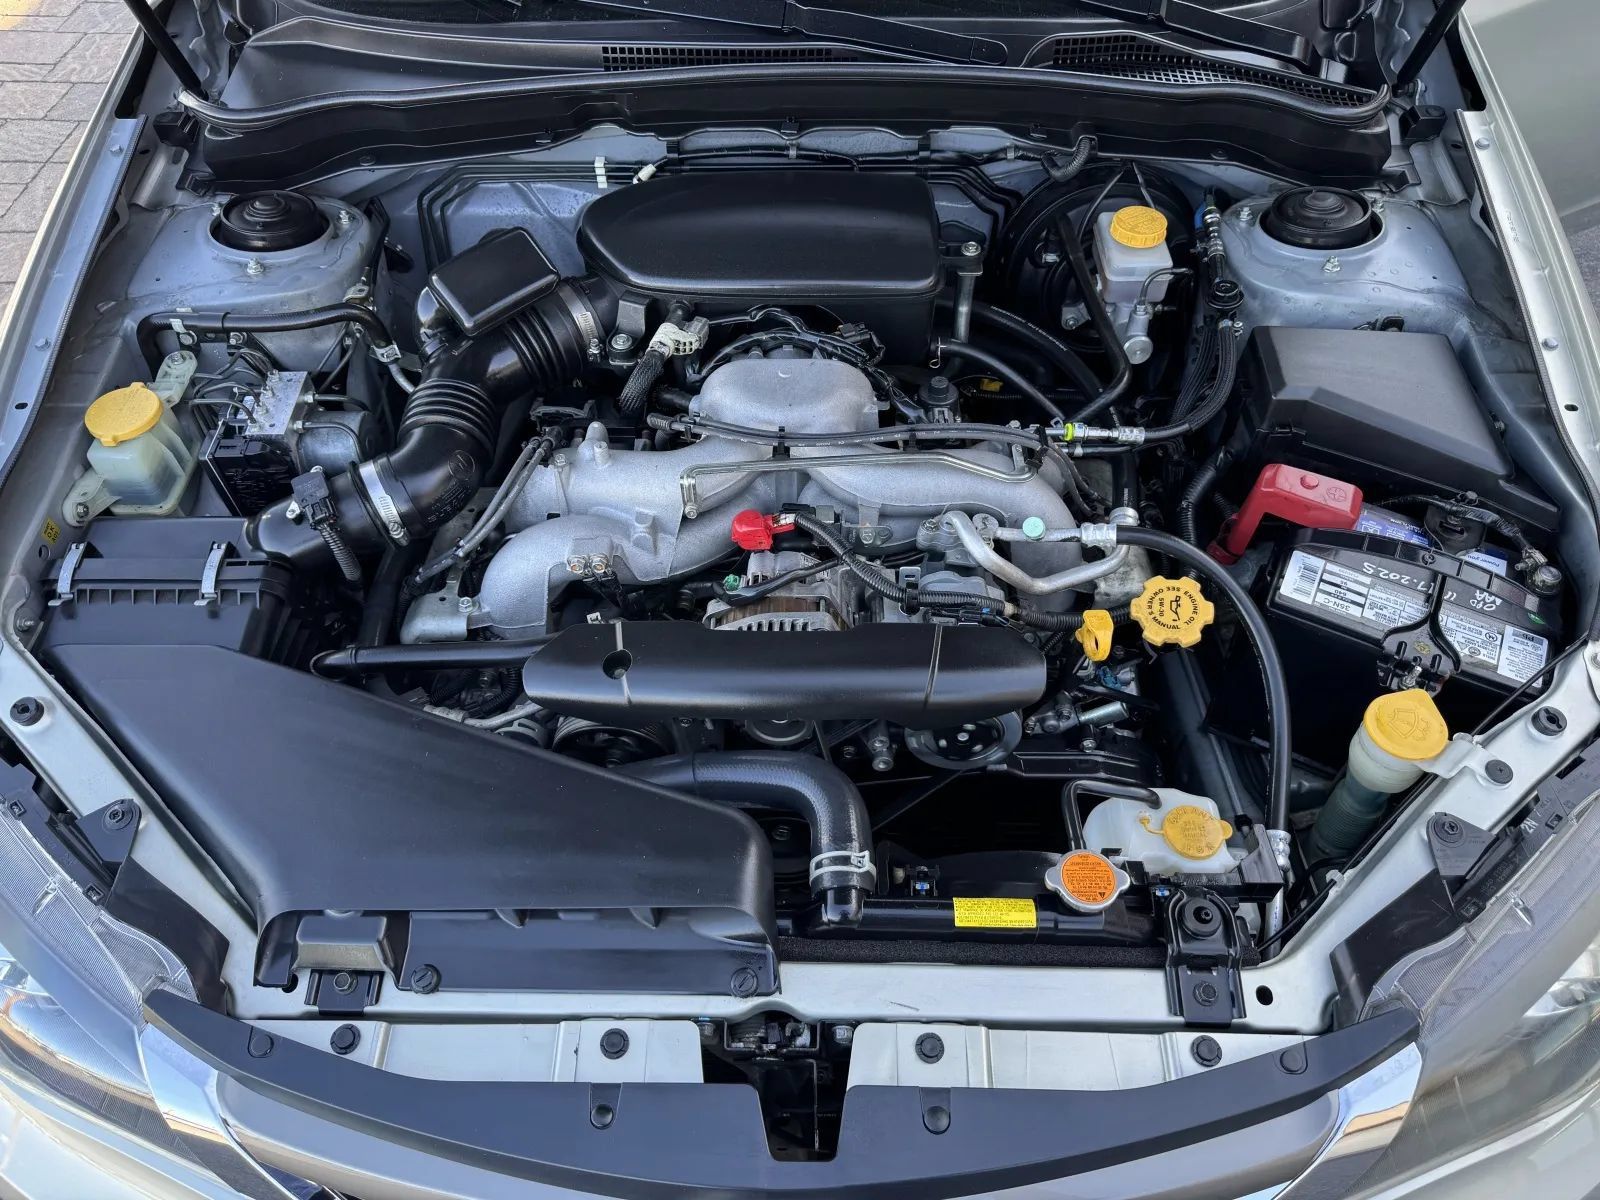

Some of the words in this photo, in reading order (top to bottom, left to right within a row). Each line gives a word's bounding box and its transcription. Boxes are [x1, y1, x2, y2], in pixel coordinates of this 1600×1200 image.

[1183, 590, 1199, 616] ENGINE
[1151, 616, 1181, 630] MANUAL
[1184, 616, 1195, 626] OIL
